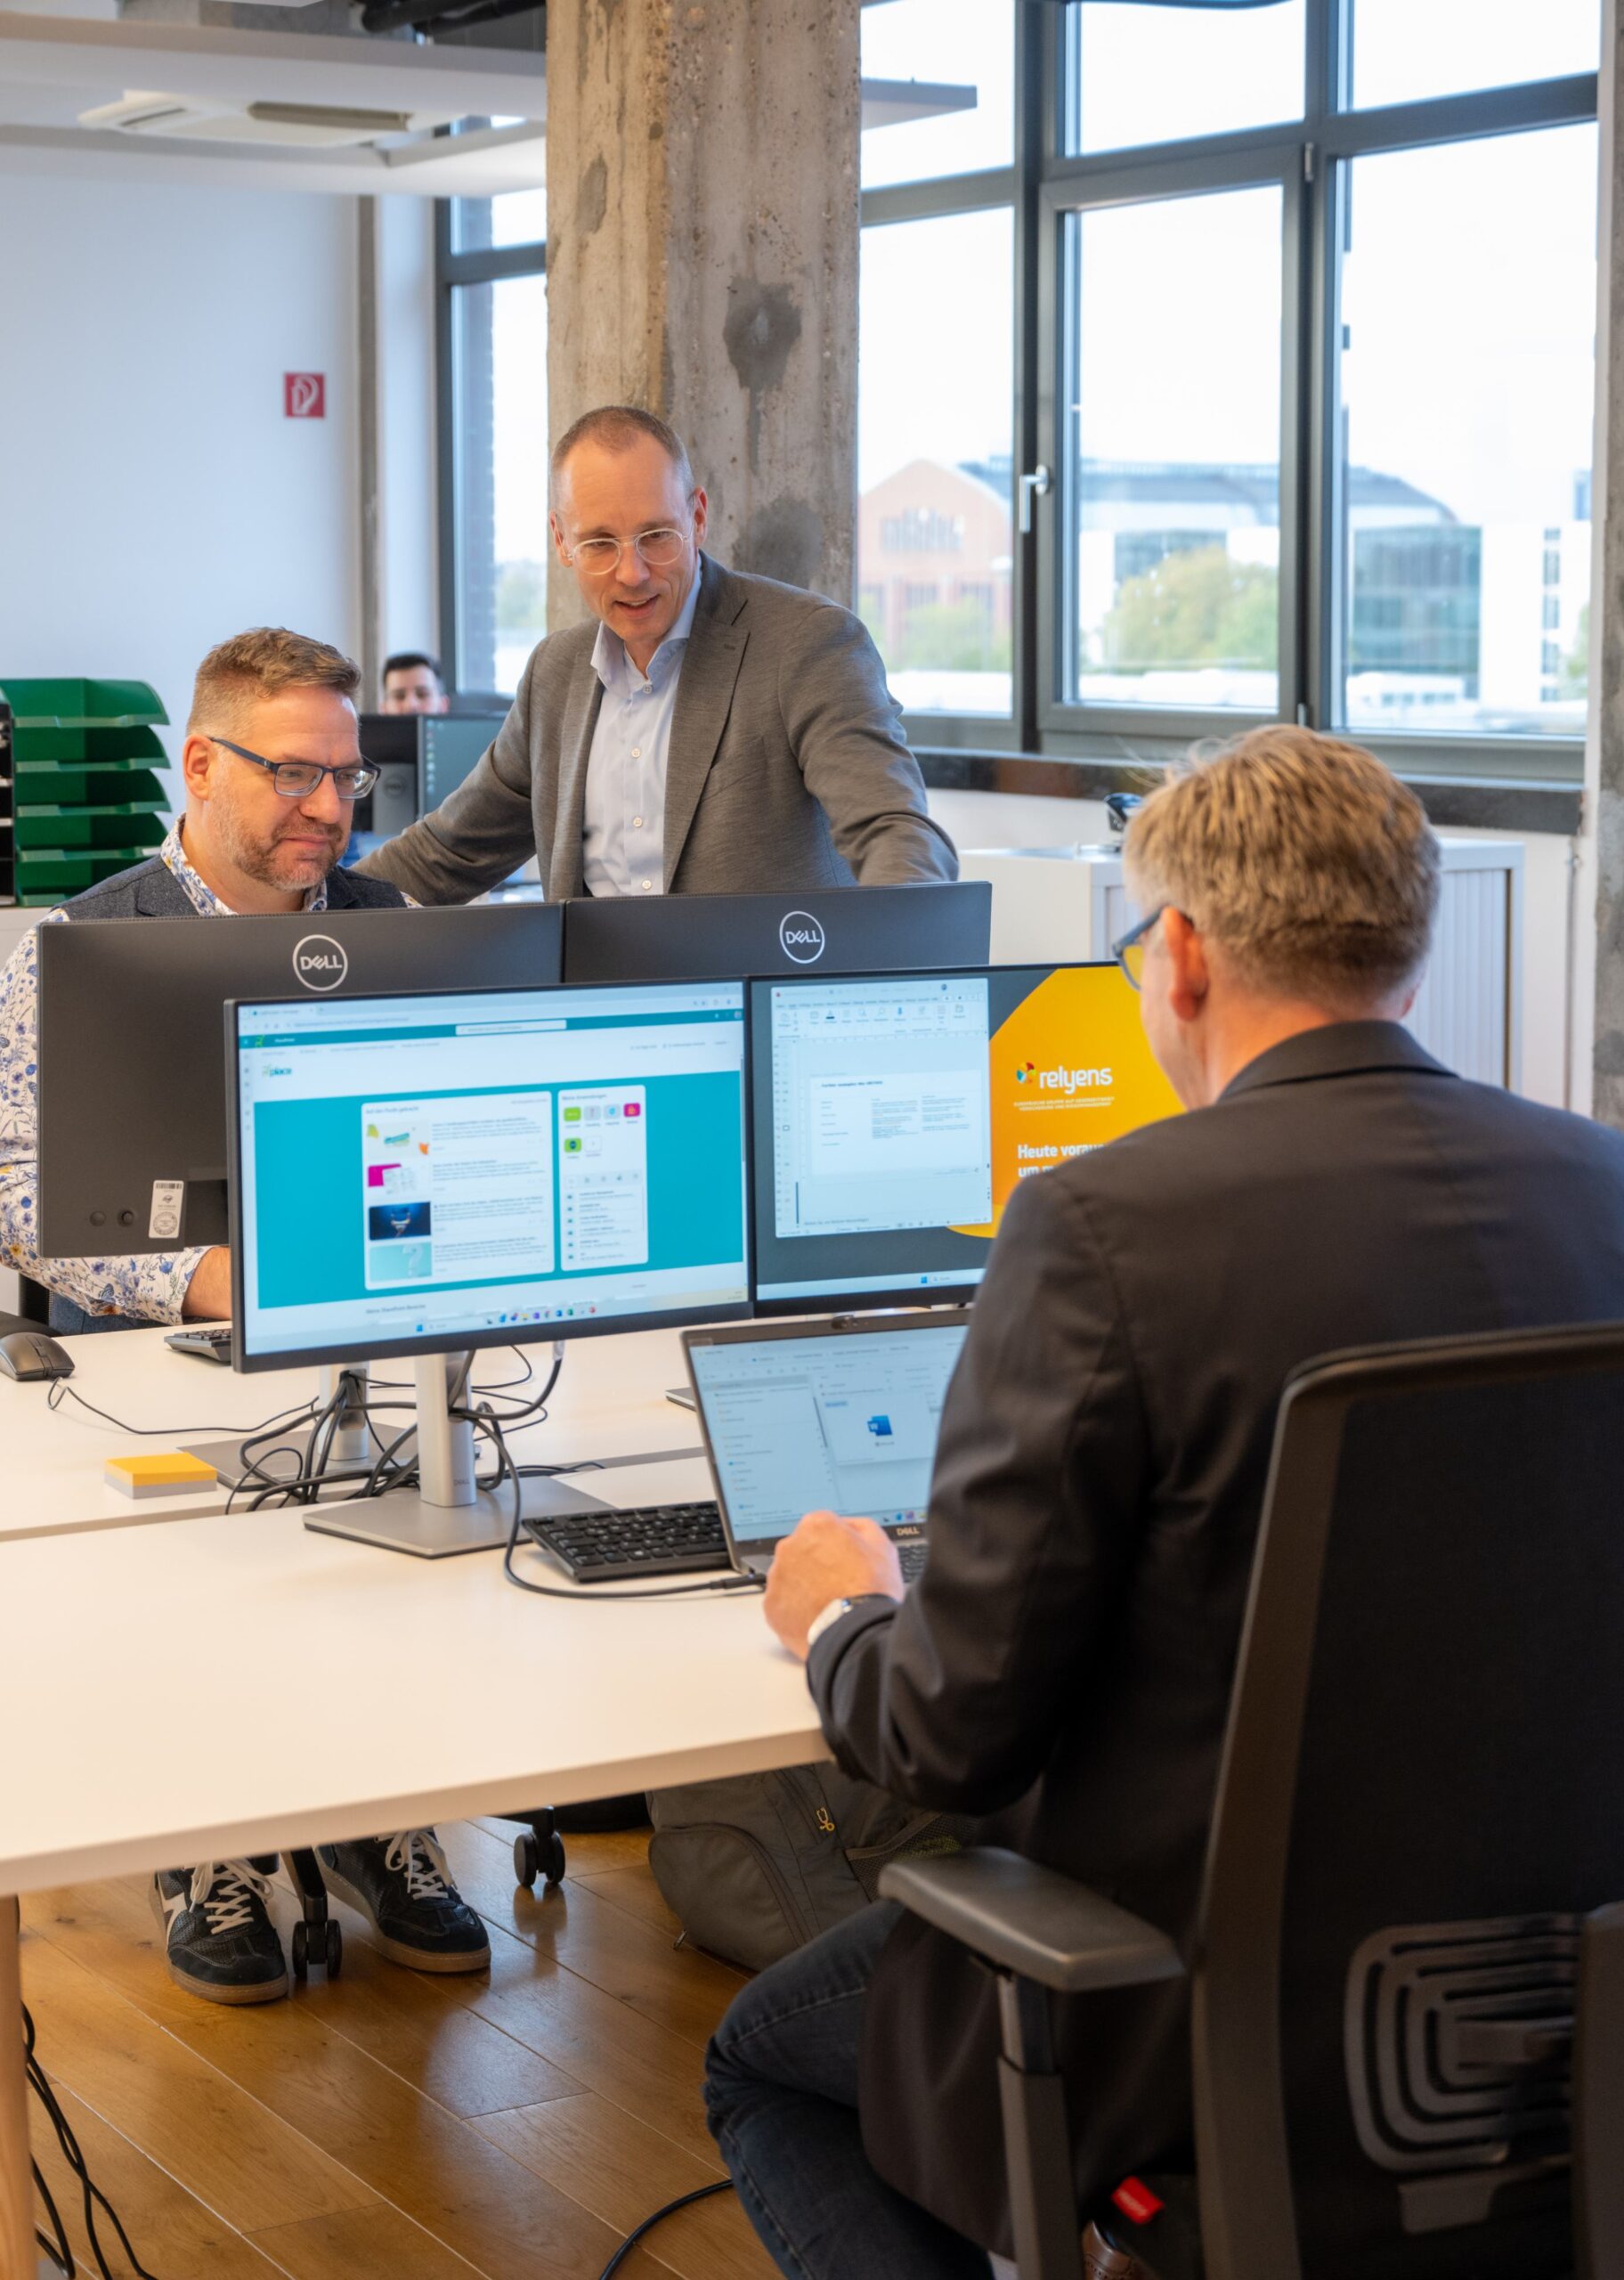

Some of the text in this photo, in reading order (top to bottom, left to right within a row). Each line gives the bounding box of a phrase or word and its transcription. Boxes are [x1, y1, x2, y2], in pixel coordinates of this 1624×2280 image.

[784, 930, 821, 944] DELL
[299, 954, 343, 971] DELL
[1039, 1064, 1112, 1095] relyens
[1018, 1144, 1057, 1159] Heute
[1018, 1166, 1040, 1177] um
[897, 1526, 921, 1536] DELL
